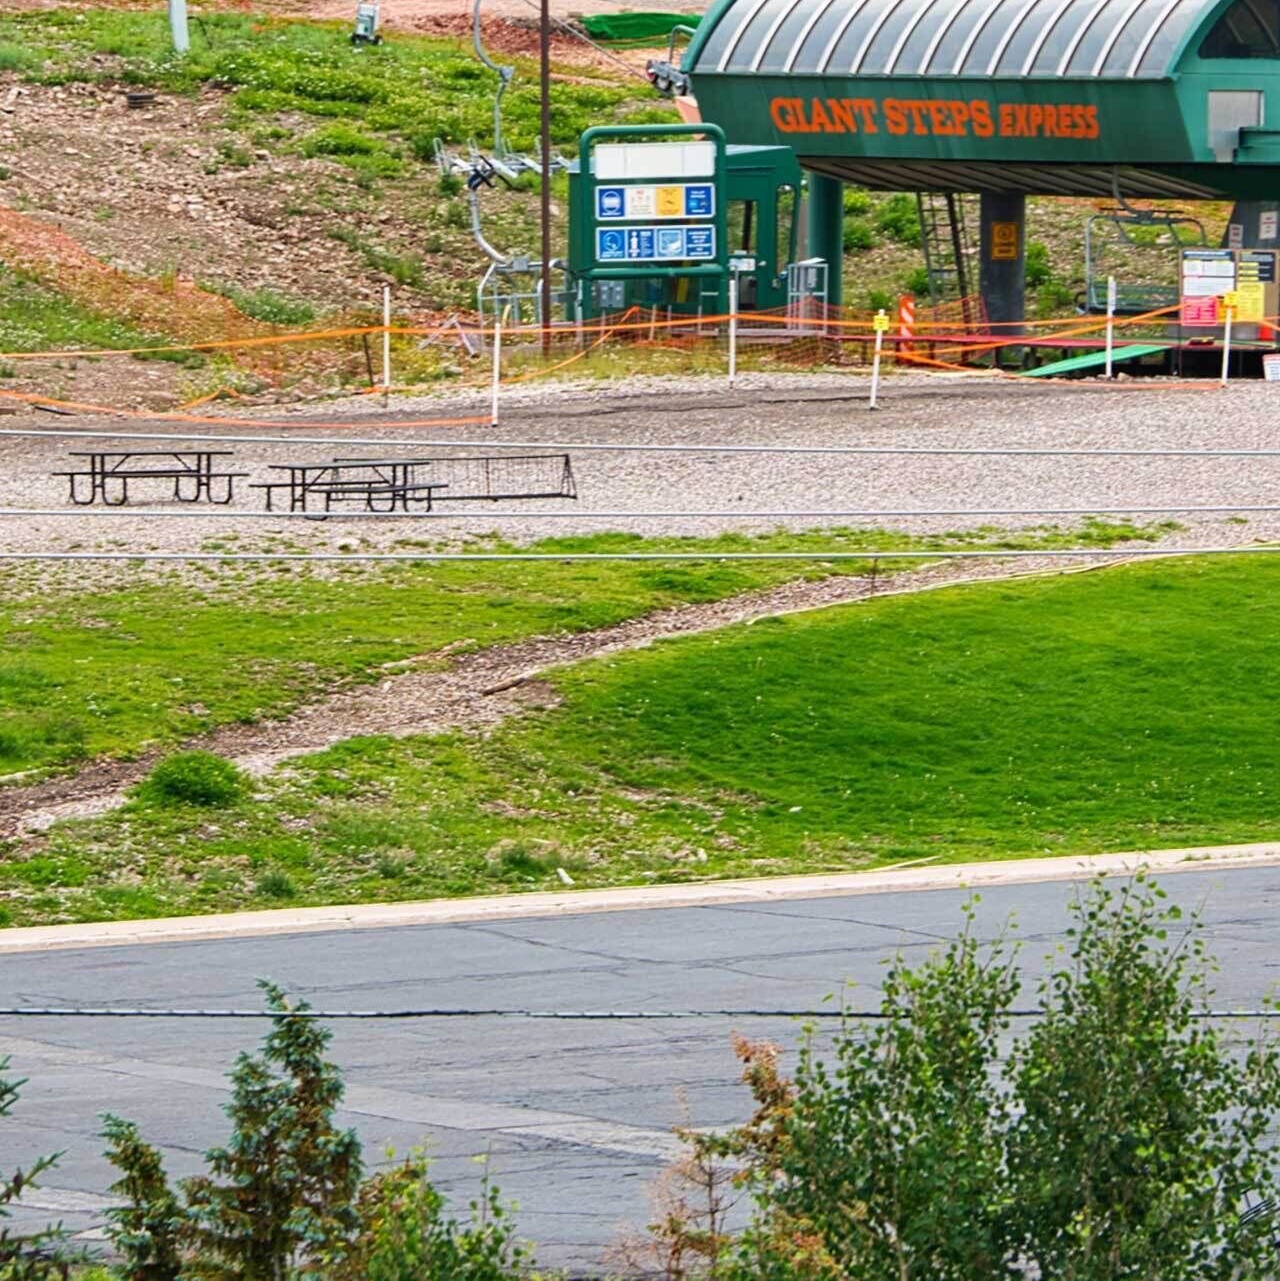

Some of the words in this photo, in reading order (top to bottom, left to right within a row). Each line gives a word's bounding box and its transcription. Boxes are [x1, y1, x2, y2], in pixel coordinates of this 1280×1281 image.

[770, 97, 878, 134] GIANT
[882, 98, 995, 138] STEPS
[999, 103, 1100, 139] EXPRESS
